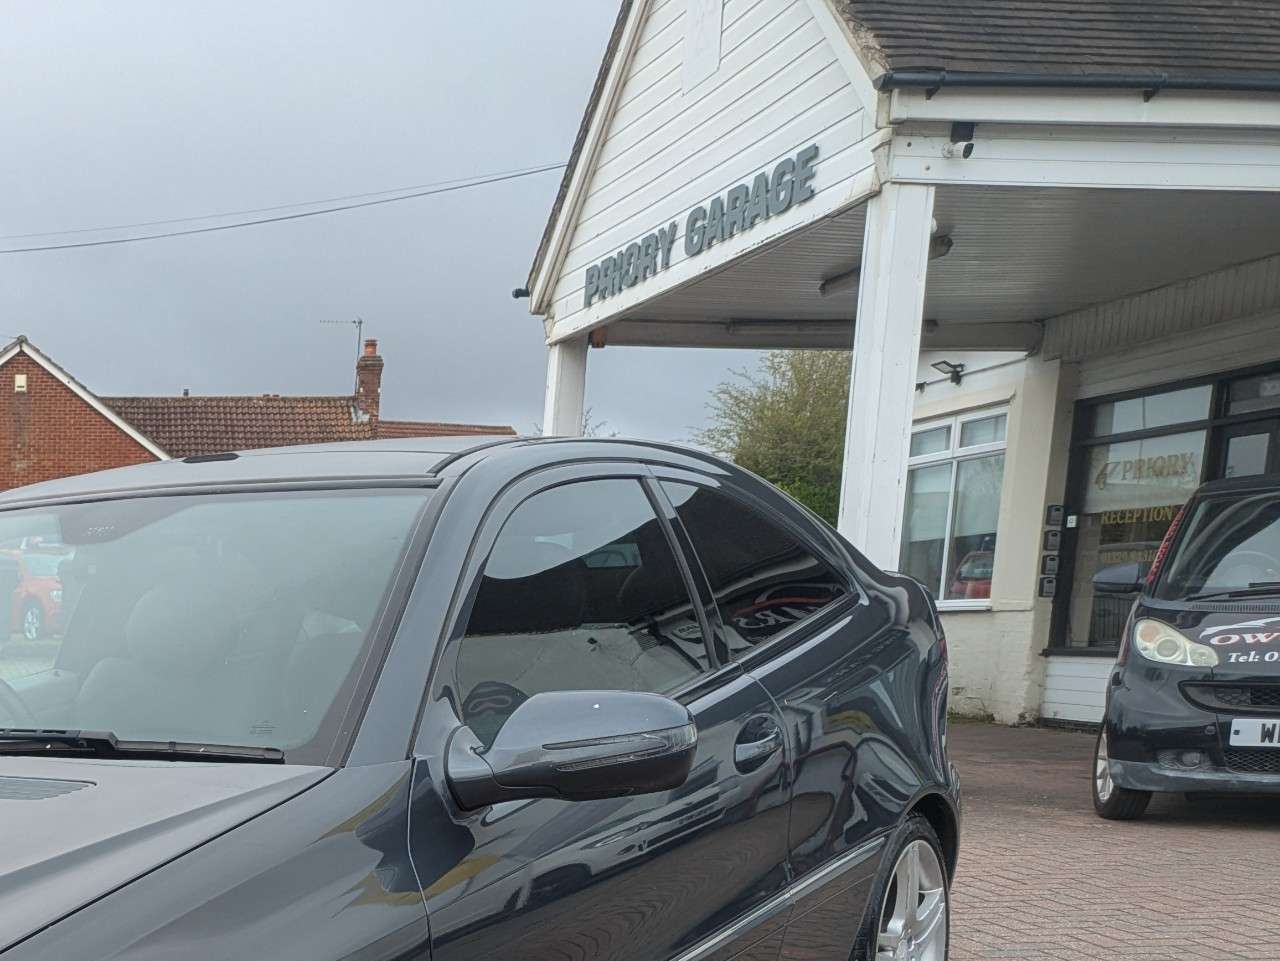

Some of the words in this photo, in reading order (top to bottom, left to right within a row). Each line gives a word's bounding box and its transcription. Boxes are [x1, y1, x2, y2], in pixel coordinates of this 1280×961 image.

[584, 220, 678, 307] PRIORY
[685, 143, 819, 257] GARAGE
[1120, 452, 1197, 481] PRIORY
[1102, 505, 1174, 525] RECEPTION
[1228, 651, 1260, 663] Tel:
